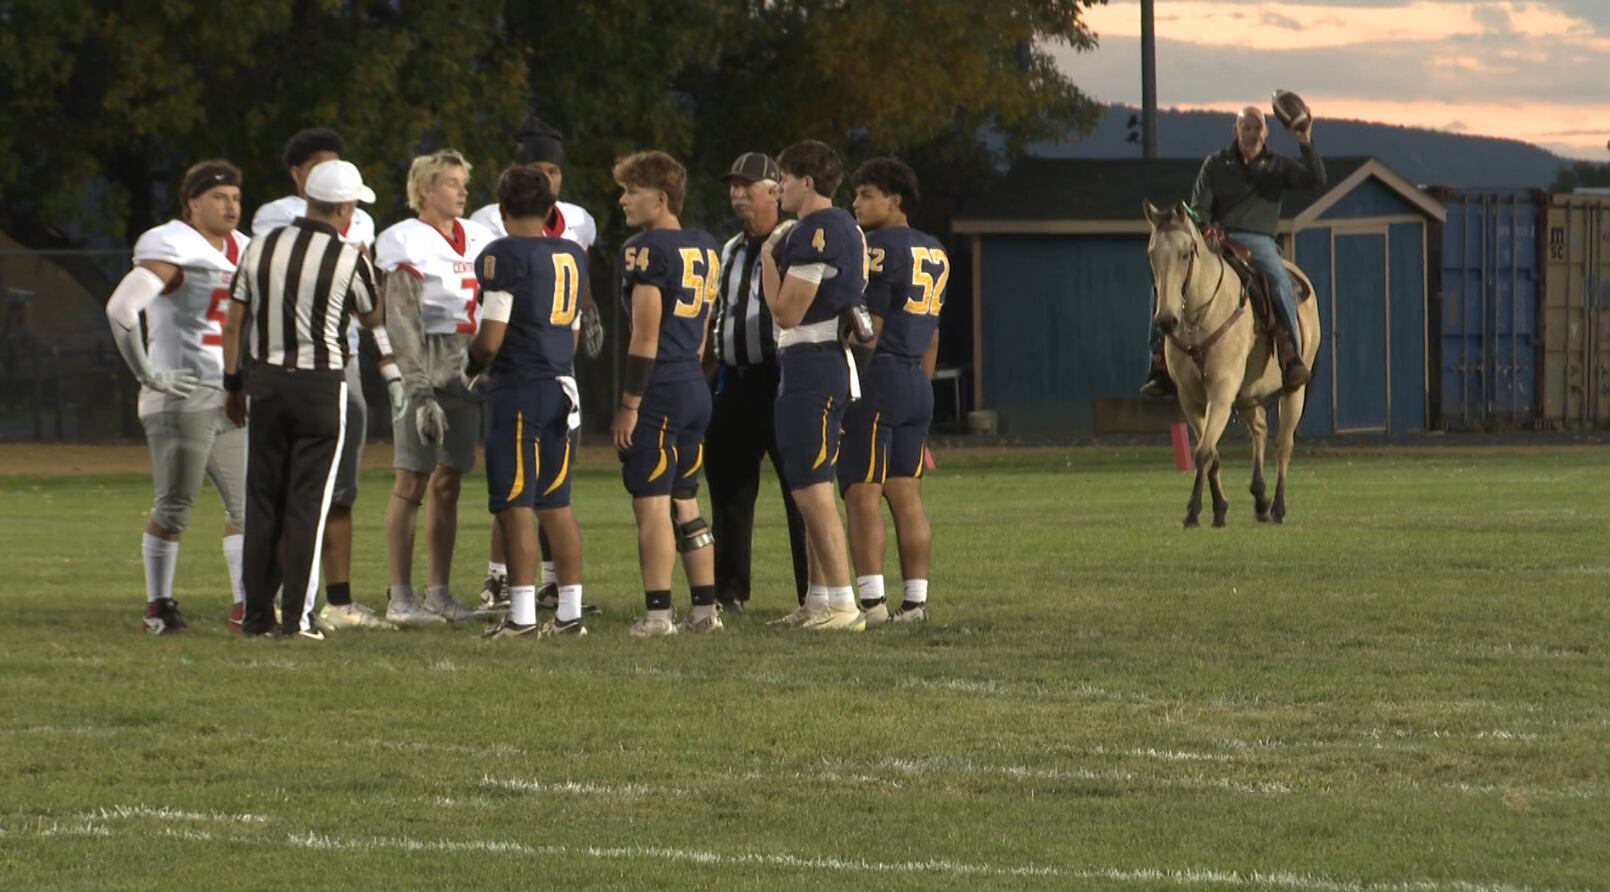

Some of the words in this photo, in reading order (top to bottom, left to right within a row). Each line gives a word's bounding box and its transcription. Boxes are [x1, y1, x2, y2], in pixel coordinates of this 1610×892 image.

[625, 246, 650, 271] 54
[811, 228, 825, 252] 4
[456, 278, 478, 334] 3
[673, 246, 720, 318] 54
[903, 247, 950, 316] 52
